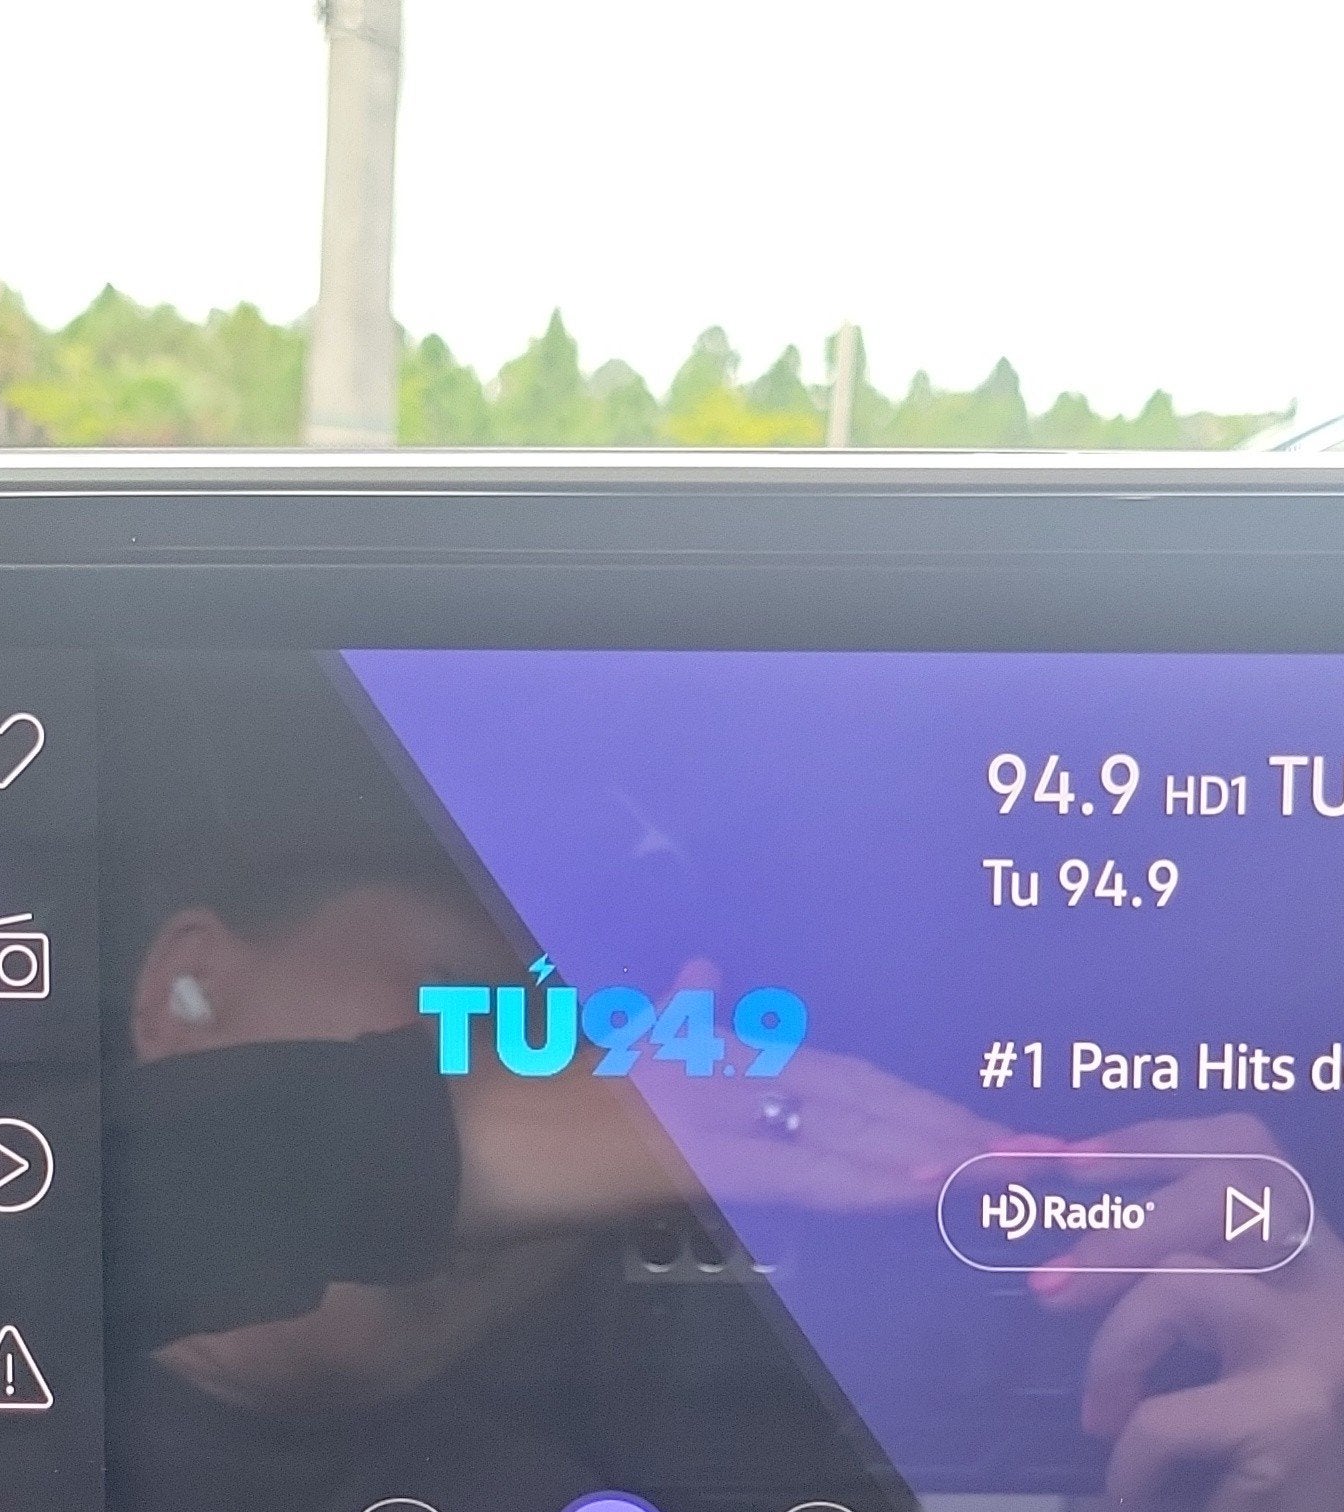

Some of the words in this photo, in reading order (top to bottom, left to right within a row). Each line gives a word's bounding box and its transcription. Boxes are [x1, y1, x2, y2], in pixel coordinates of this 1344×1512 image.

[987, 753, 1140, 815] 94.9
[1165, 775, 1247, 815] HD1
[983, 859, 1038, 906] Tu
[1059, 859, 1179, 907] 94.9
[979, 1042, 1043, 1088] #1
[1072, 1042, 1179, 1089] Para
[1198, 1043, 1294, 1090] Hits
